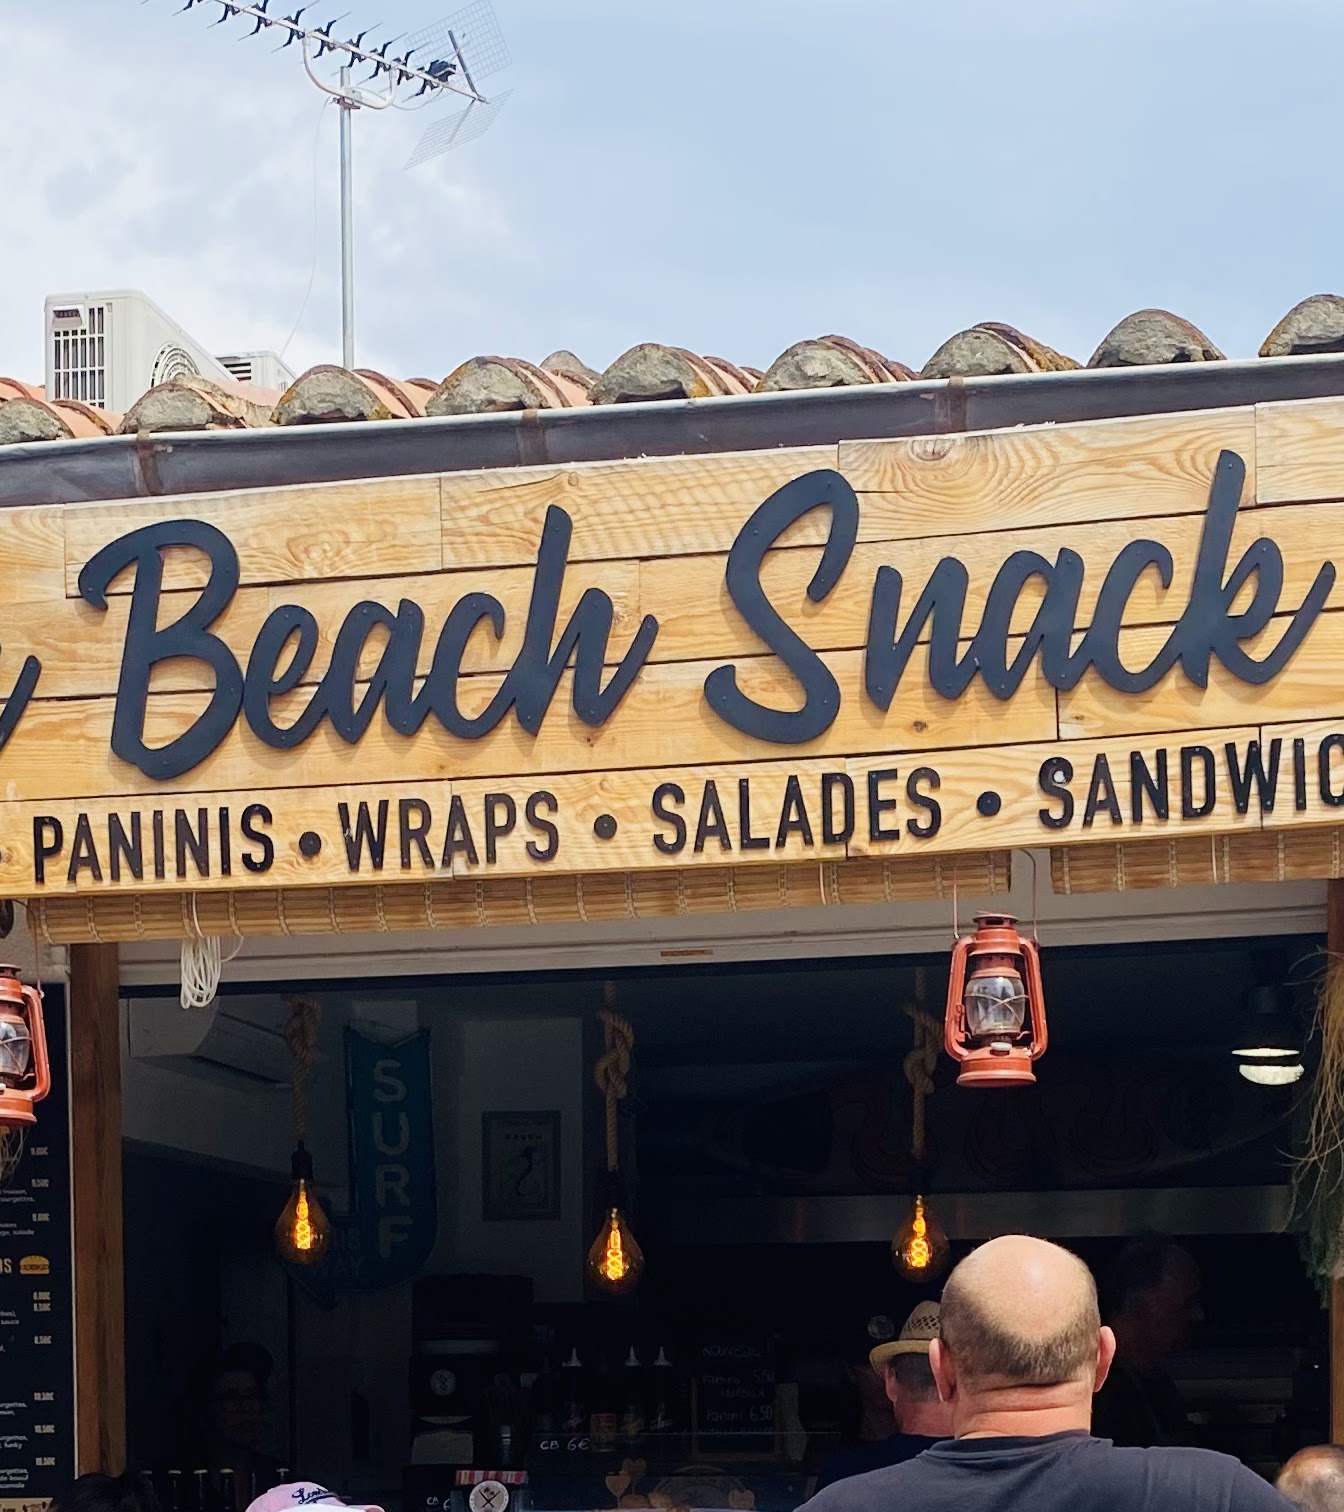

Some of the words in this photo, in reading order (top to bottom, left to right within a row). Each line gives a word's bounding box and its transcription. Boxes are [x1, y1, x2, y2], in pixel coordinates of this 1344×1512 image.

[78, 503, 659, 780] Beach
[704, 449, 1335, 744] Snack
[32, 801, 274, 884] PANINIS
[338, 790, 559, 873] WRAPS
[652, 766, 943, 854] SALADES
[372, 1057, 415, 1260] SURF
[567, 1437, 591, 1451] 6€
